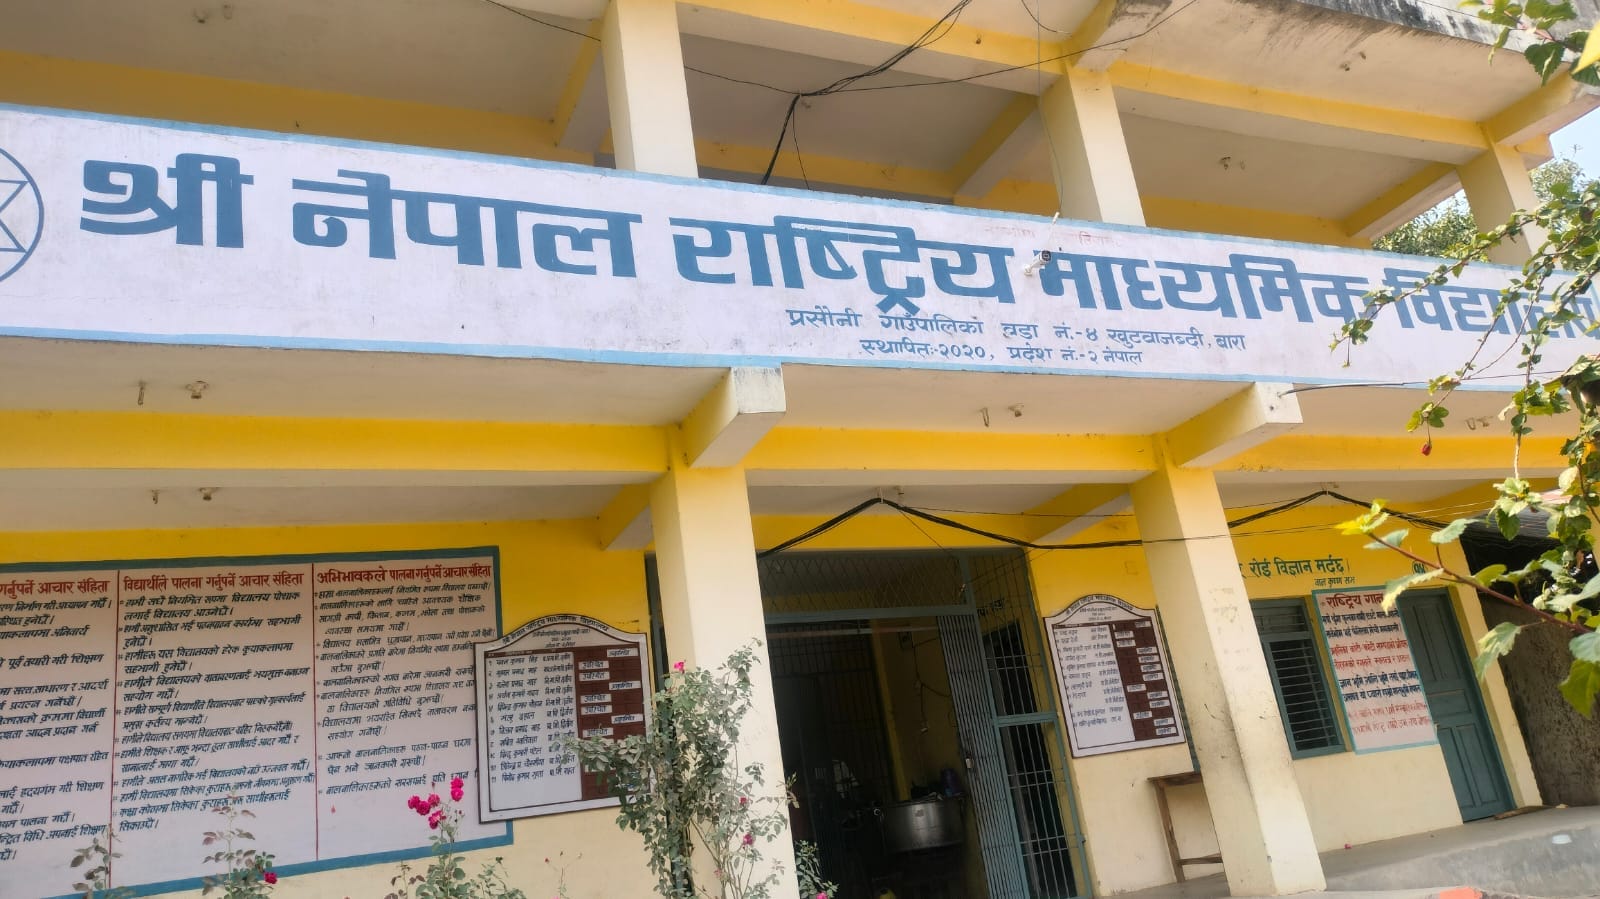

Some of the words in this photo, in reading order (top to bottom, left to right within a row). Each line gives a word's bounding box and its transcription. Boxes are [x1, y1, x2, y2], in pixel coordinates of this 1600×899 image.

[80, 153, 254, 249] श्री
[292, 169, 642, 277] नेपाल
[669, 215, 1014, 315] राष्ट्रिय
[1034, 249, 1373, 323] माध्यमिक
[879, 312, 984, 337] गाउँपालिका
[1214, 334, 1246, 349] बारा
[1007, 342, 1053, 362] प्रदेश
[1103, 346, 1143, 365] नेपाल
[317, 565, 388, 584] अभिभावकले
[389, 569, 415, 581] पालना
[415, 564, 443, 583] गर्नुपर्ने
[443, 566, 469, 577] आचार
[469, 562, 492, 577] संहिता
[1274, 557, 1312, 575] विज्ञान
[38, 582, 74, 594] आचार
[78, 578, 110, 593] संहिता
[124, 575, 168, 592] विद्यार्थीले
[172, 576, 203, 590] पालना
[206, 574, 236, 591] गर्नुपर्ने
[239, 574, 270, 587] आचार
[273, 571, 304, 585] संहिता
[168, 595, 201, 605] नियमित
[231, 592, 270, 602] विद्यालय
[274, 591, 300, 600] पोशाक
[1326, 594, 1362, 608] राष्ट्रिय
[124, 609, 152, 620] लगाई
[153, 608, 191, 618] विद्यालय
[268, 614, 302, 625] सहभागी
[51, 625, 90, 636] अनिवार्य
[158, 648, 174, 659] यस
[177, 644, 220, 657] विद्यालयको
[221, 644, 240, 655] हरेक
[8, 656, 24, 669] पूर्व
[23, 655, 50, 667] तयारी
[52, 654, 67, 665] गरी
[71, 653, 104, 663] शिक्षण
[124, 661, 160, 674] सहभागी
[72, 683, 77, 691] र
[78, 679, 108, 691] आदर्श
[123, 675, 154, 690] हामीले
[156, 672, 203, 686] विद्यालयको
[123, 690, 152, 702] सहयोग
[322, 714, 362, 728] विद्यालयमा
[53, 725, 78, 737] प्रदान
[82, 722, 99, 733] गर्न
[59, 754, 87, 764] पक्षपात
[90, 751, 109, 760] रहित
[142, 746, 168, 757] शिक्षक
[191, 743, 210, 753] भन्दा
[121, 777, 144, 788] हामीले
[209, 766, 248, 779] विद्यालयको
[59, 781, 73, 793] गरी
[77, 781, 104, 791] शिक्षण
[120, 791, 138, 802] हामी
[139, 787, 178, 800] विद्यालयमा
[119, 808, 138, 818] कक्षा
[139, 804, 171, 815] कोठामा
[171, 800, 199, 811] सिकेका
[21, 817, 48, 827] पालना
[23, 829, 44, 841] विधि
[46, 824, 78, 840] अपनाई
[80, 824, 106, 836] शिक्षण
